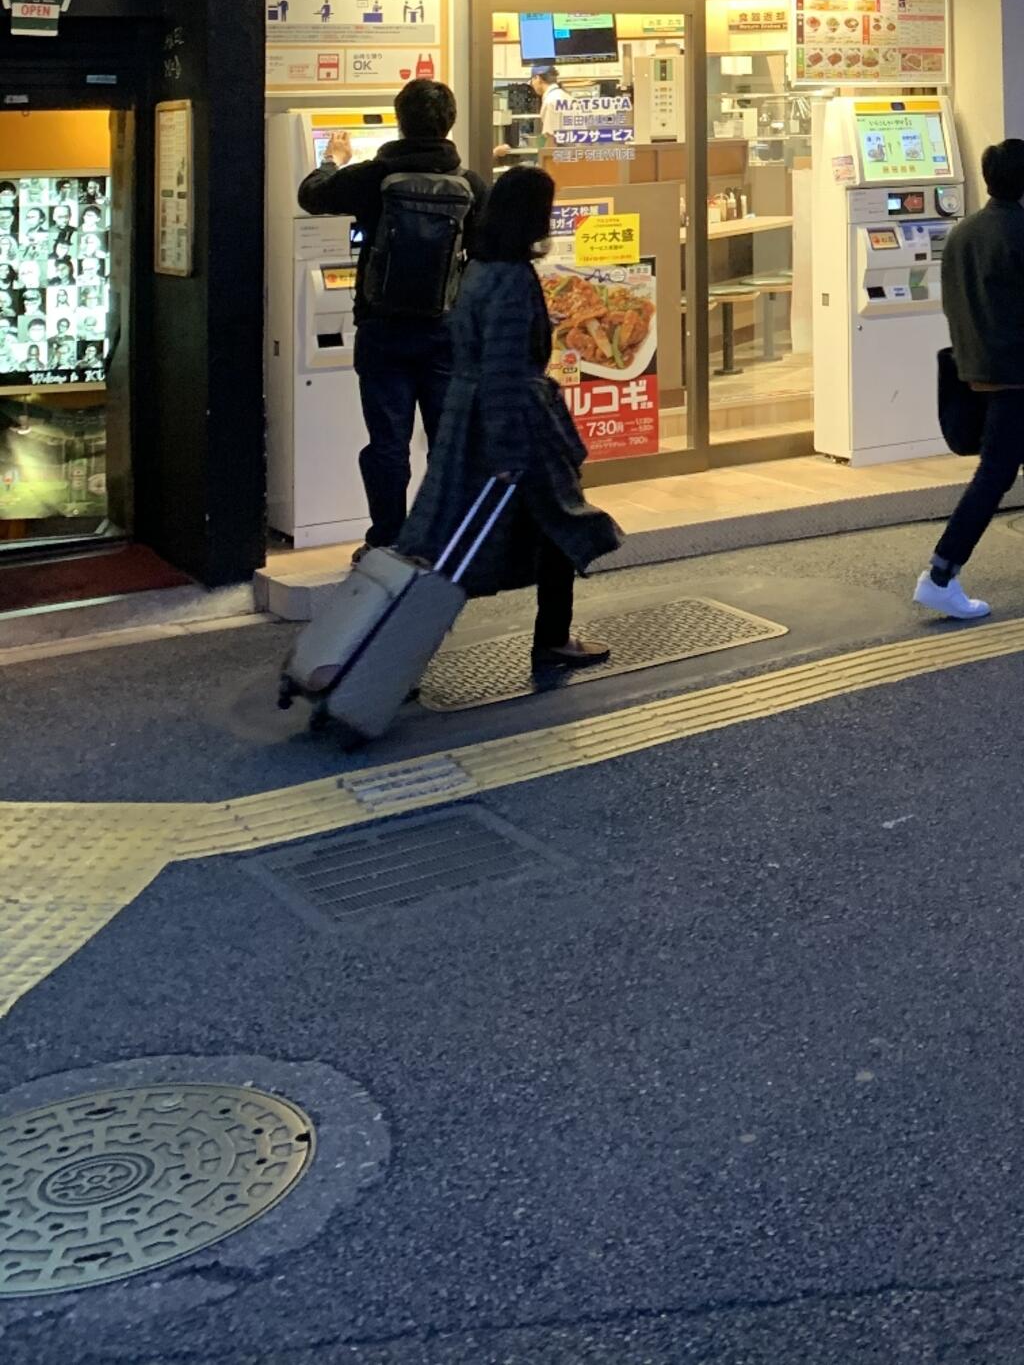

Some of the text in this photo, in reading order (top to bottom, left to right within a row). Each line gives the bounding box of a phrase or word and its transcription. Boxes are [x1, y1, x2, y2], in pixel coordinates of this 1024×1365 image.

[20, 4, 51, 17] OPEN
[352, 60, 372, 71] OK
[555, 98, 631, 111] MATSUYA
[553, 129, 634, 143] セルフサービス
[580, 228, 635, 244] ライス大盛
